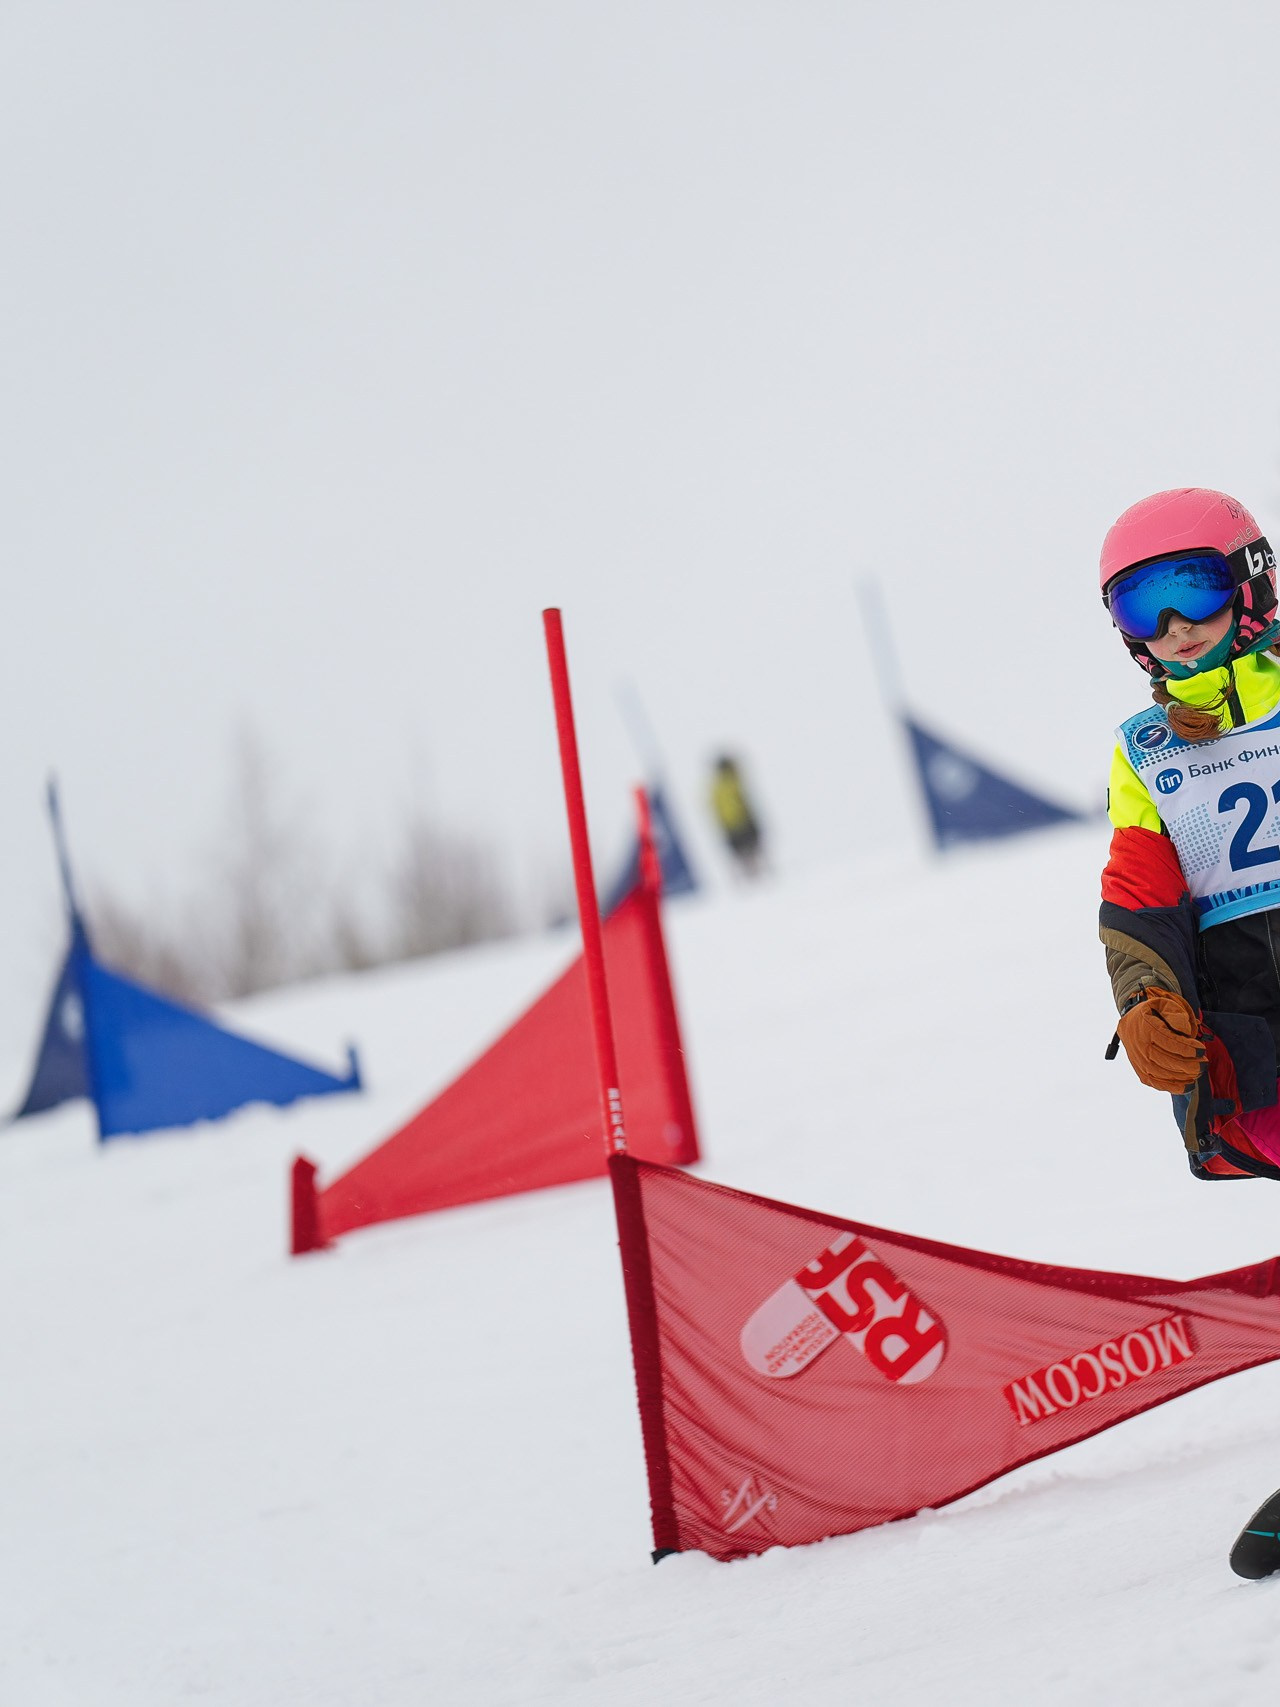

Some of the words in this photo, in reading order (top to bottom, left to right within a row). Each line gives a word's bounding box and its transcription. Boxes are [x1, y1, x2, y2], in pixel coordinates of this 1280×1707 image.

[1188, 757, 1236, 778] Банк
[1158, 773, 1181, 792] fin
[1012, 1317, 1194, 1426] MOSCOW
